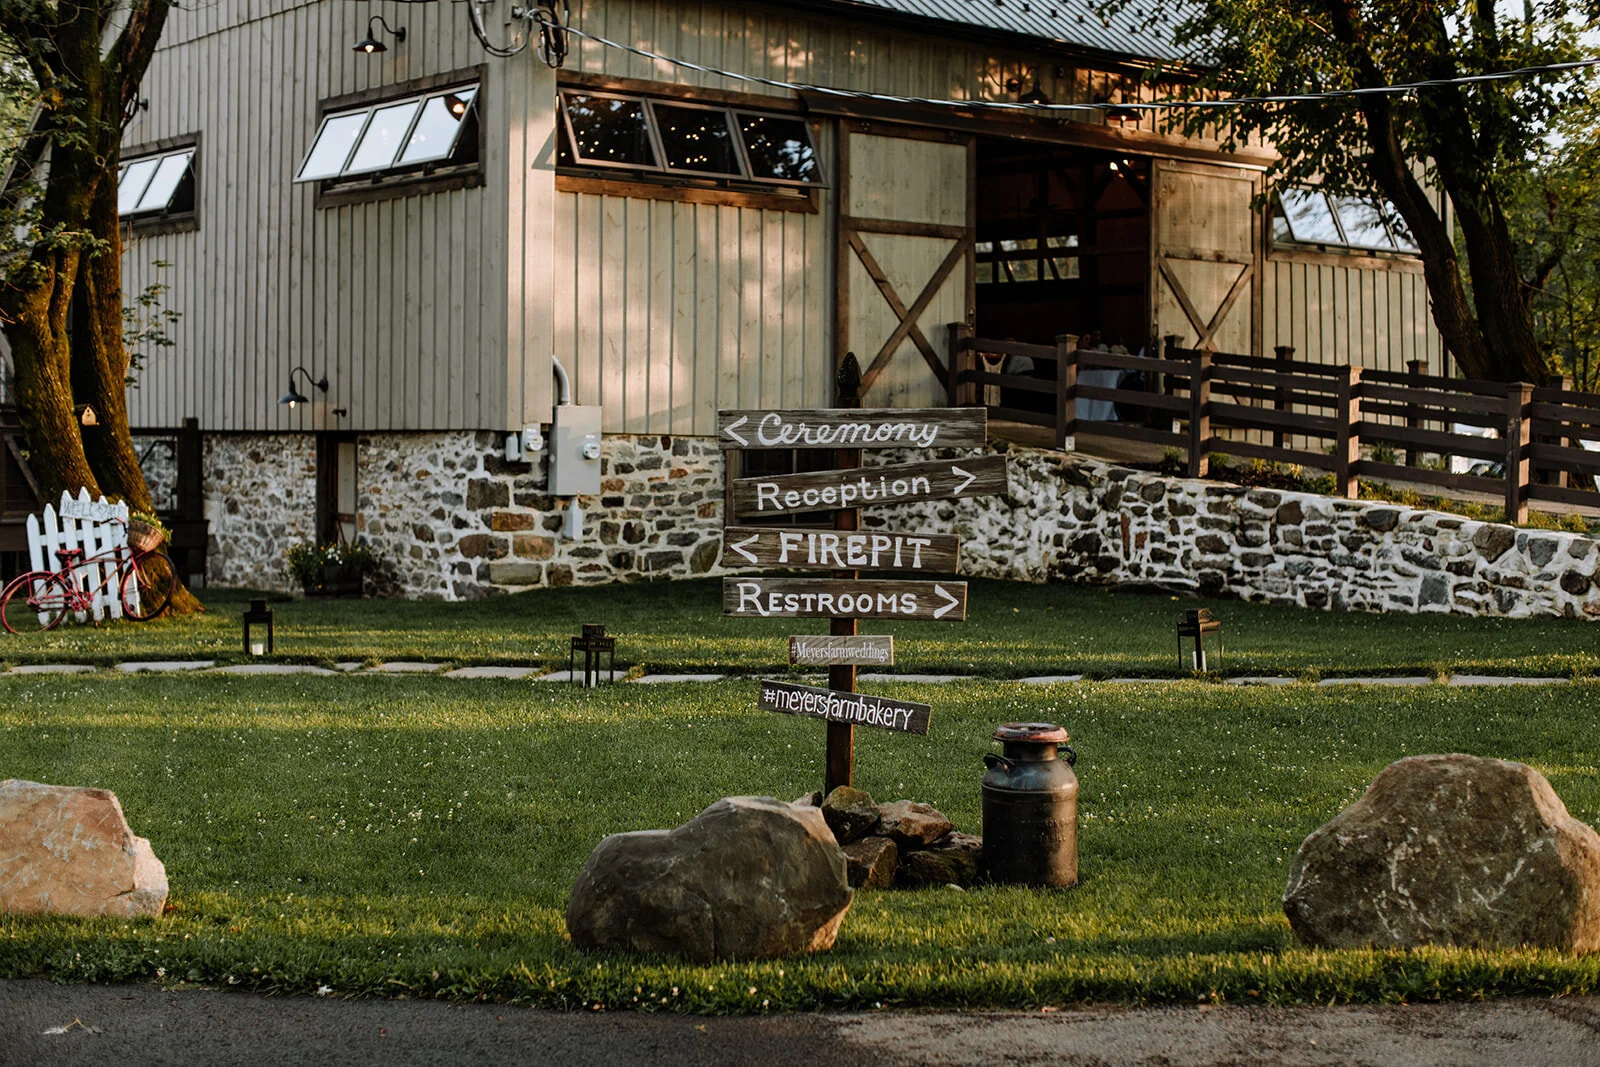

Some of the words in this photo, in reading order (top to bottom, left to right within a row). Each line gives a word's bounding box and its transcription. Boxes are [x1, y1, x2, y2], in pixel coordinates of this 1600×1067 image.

[758, 412, 938, 448] Ceremony
[757, 477, 930, 511] Reception
[778, 532, 931, 569] FIREPIT
[736, 583, 918, 617] RESTROOMS
